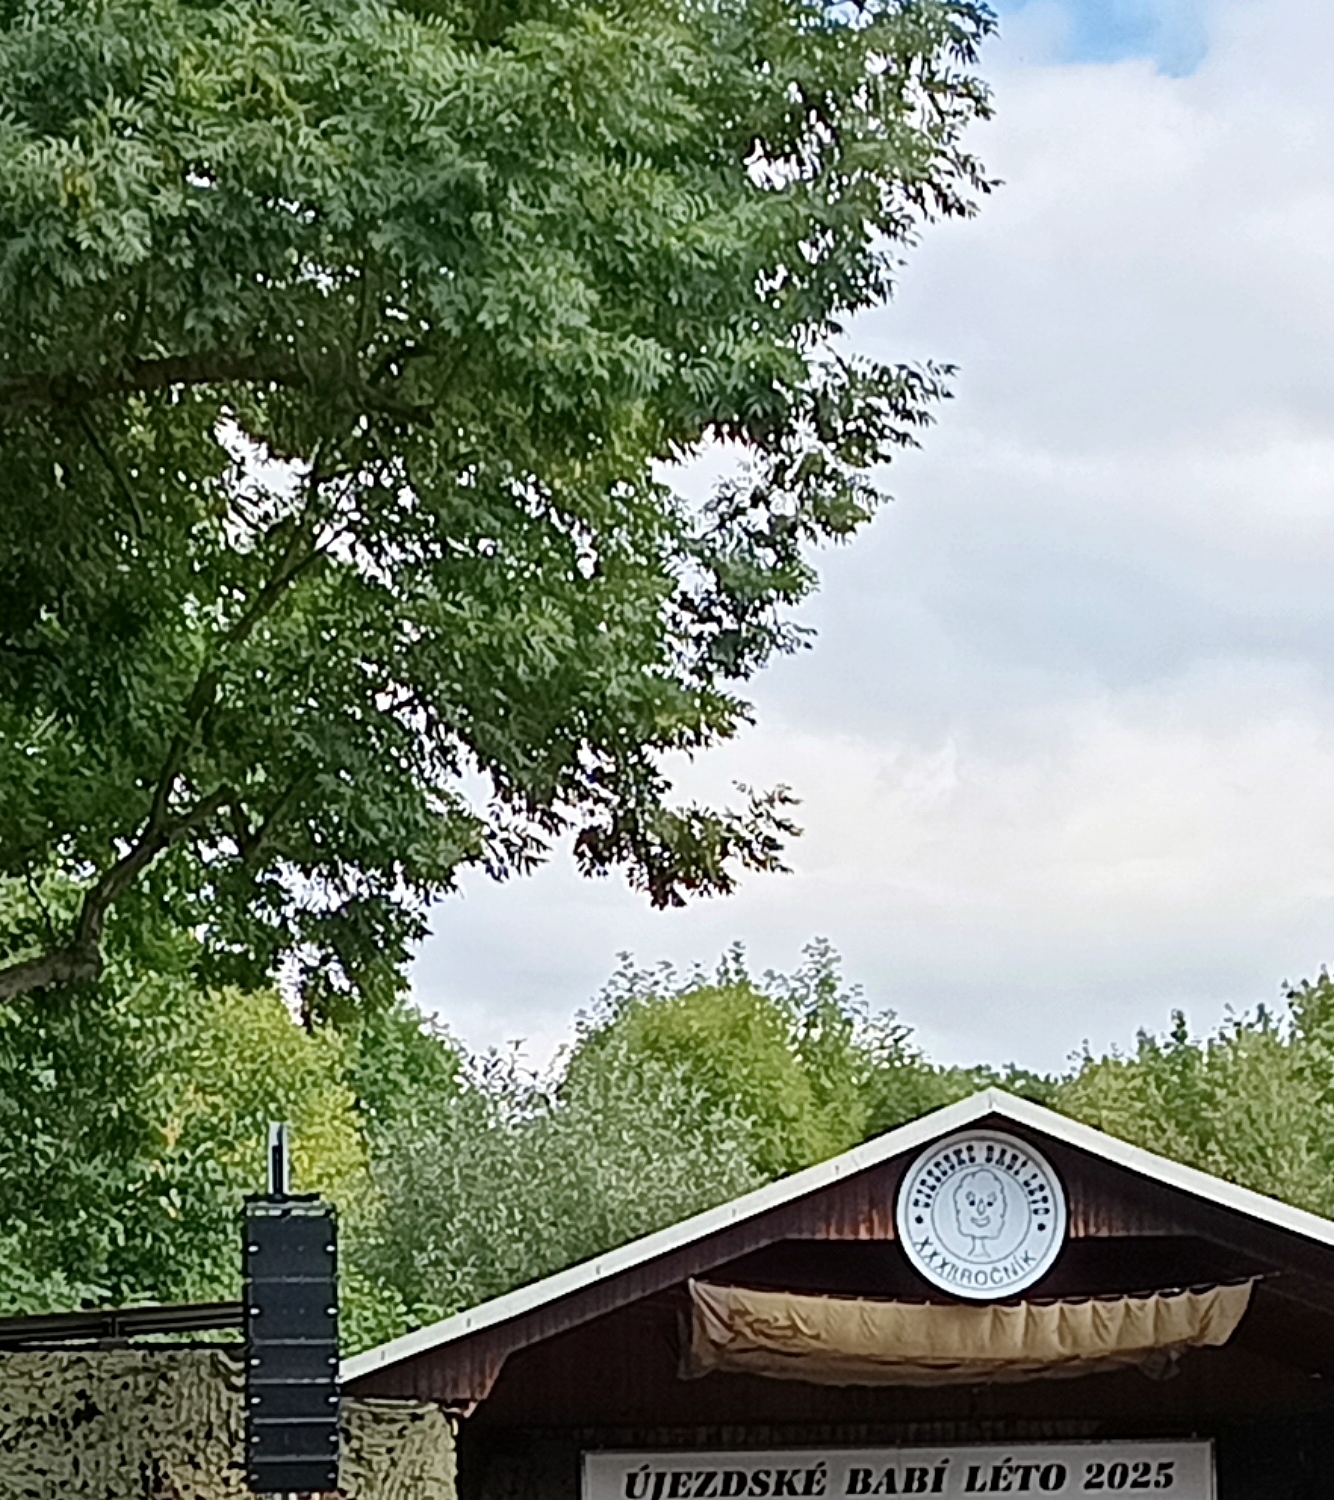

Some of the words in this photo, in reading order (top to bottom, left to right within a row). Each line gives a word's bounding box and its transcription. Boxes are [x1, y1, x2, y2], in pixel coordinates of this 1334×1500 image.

[844, 1458, 950, 1495] BABÍ
[964, 1456, 1067, 1493] LÉTO
[1083, 1461, 1175, 1491] 2025
